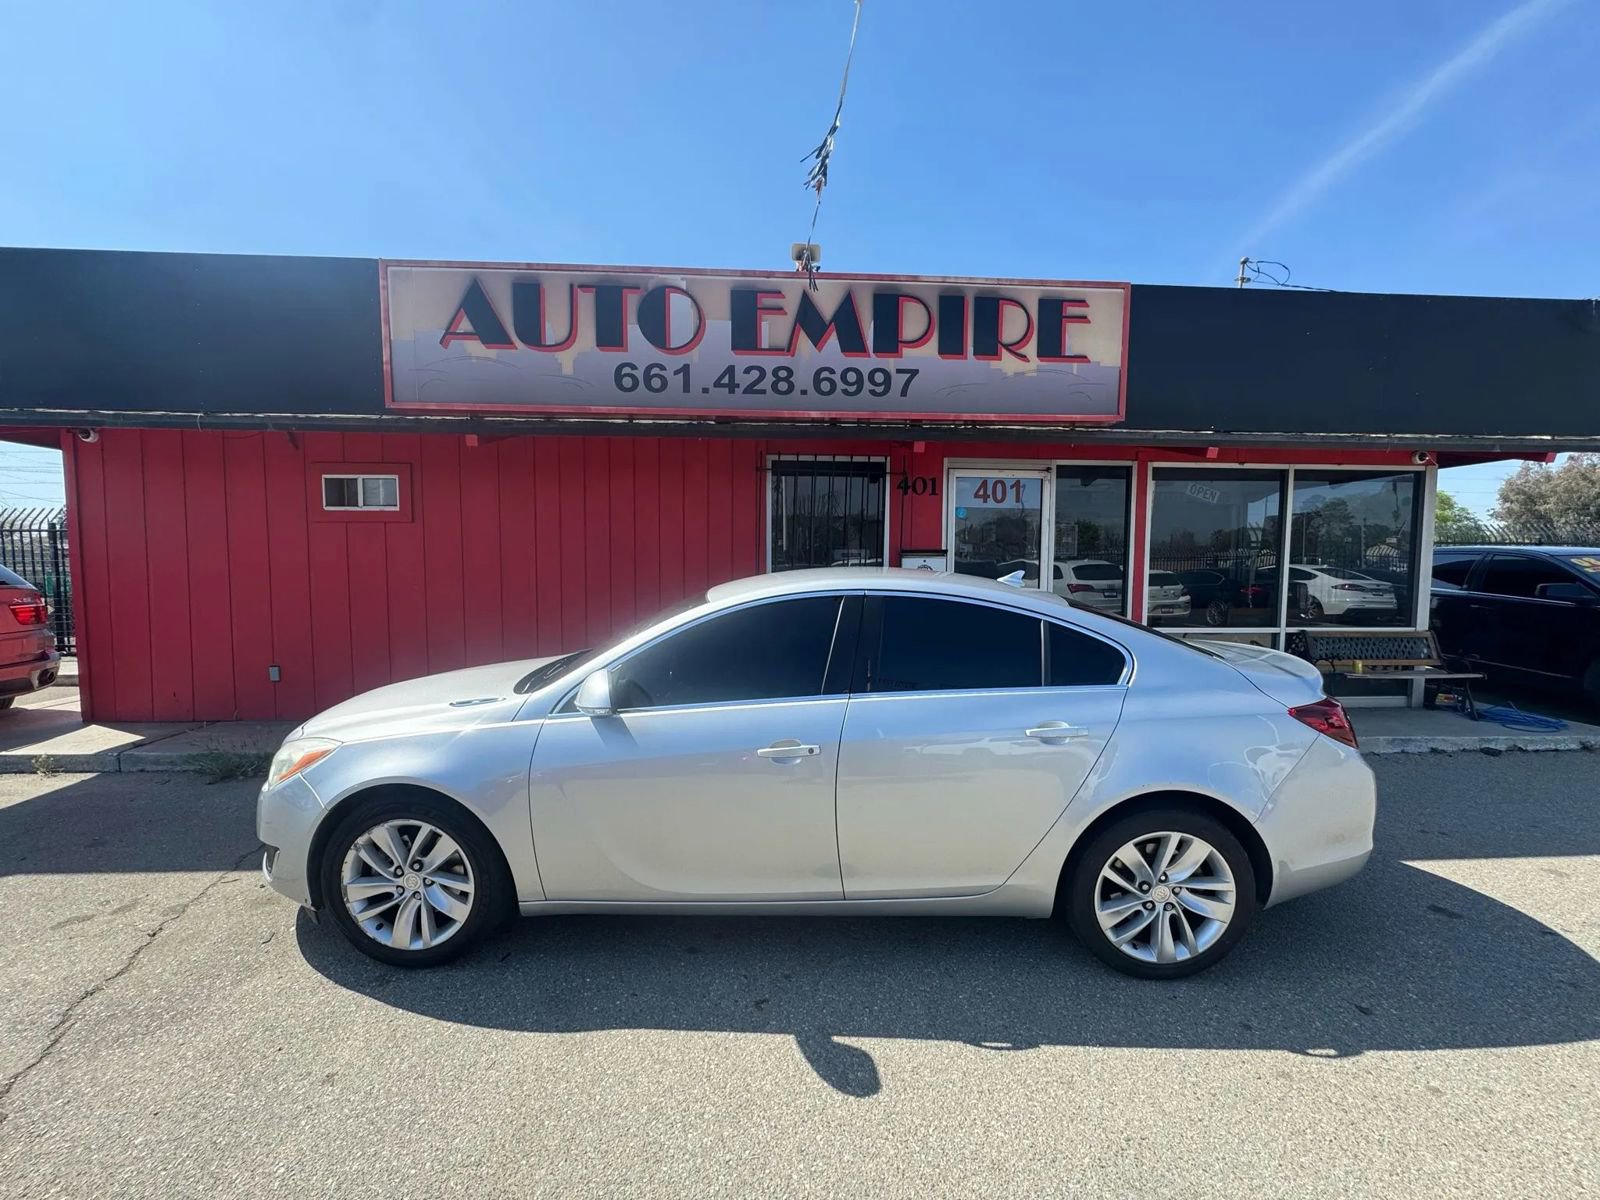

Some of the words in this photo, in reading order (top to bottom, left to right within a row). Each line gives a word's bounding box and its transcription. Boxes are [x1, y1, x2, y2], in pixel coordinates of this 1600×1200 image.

[440, 279, 706, 355] AUTO
[730, 289, 1091, 364] EMPIRE
[613, 362, 920, 398] 661.428.6997
[897, 476, 939, 496] 401
[974, 479, 1022, 504] 401
